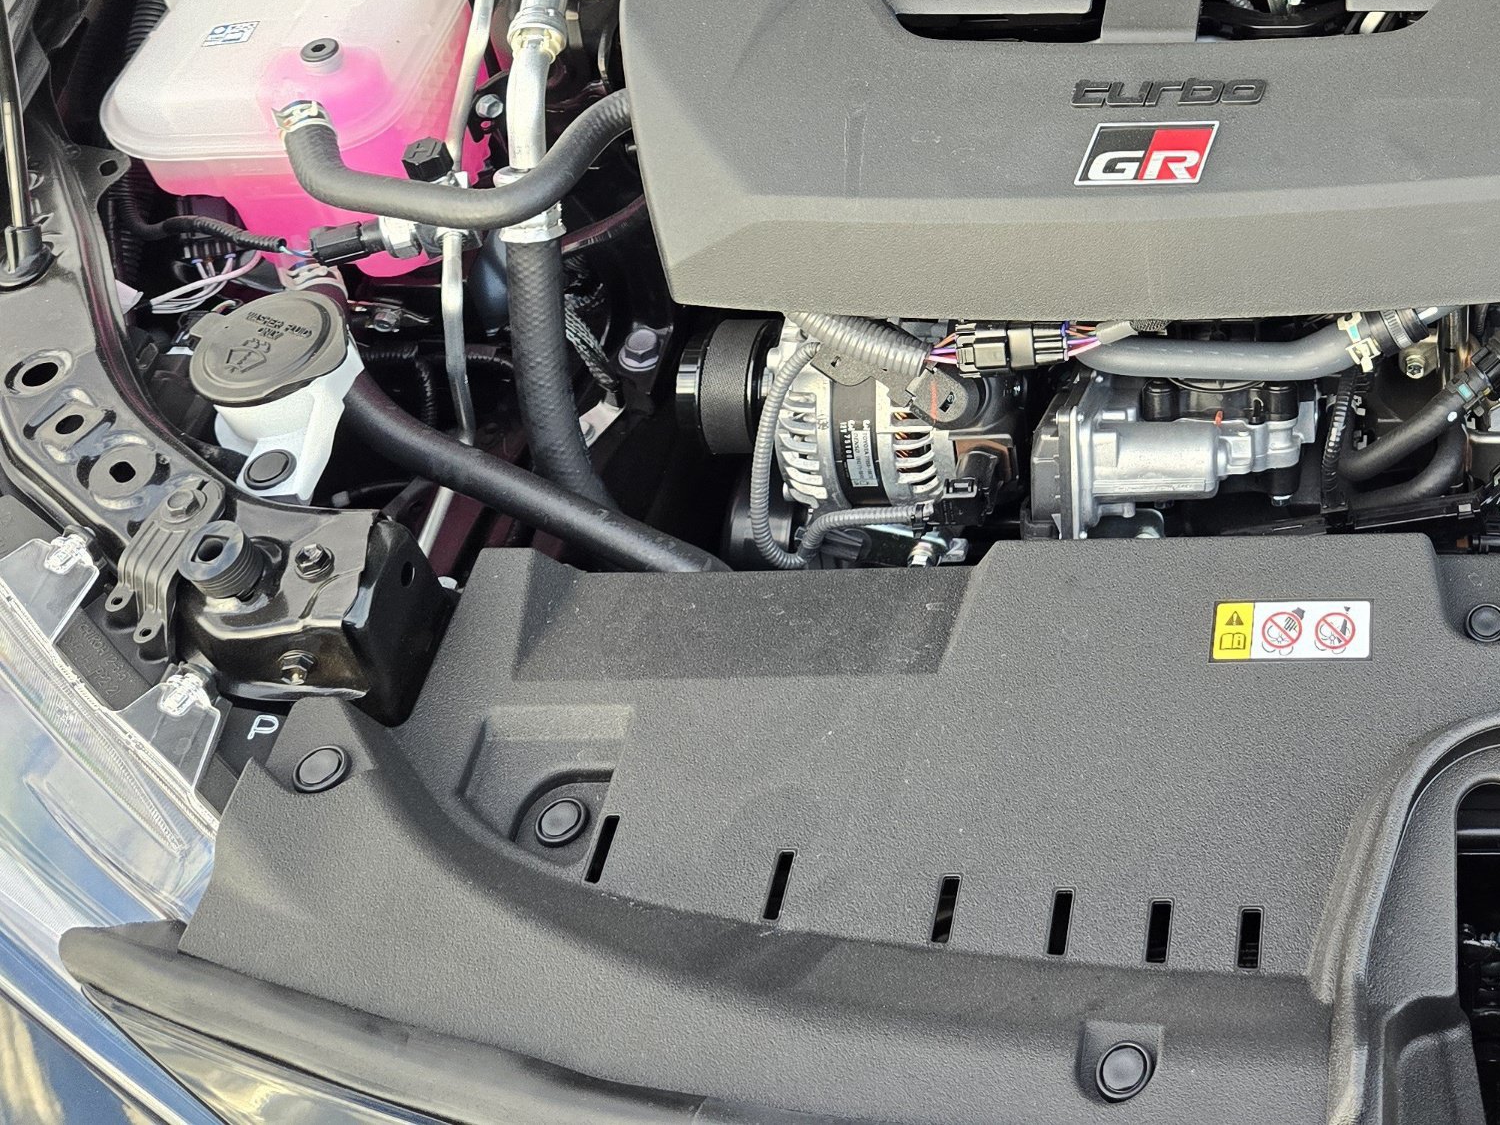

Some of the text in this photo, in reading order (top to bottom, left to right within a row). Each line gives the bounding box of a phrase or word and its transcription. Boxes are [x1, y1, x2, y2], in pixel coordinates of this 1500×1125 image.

[1070, 78, 1268, 108] turbo
[1087, 150, 1202, 180] GR
[246, 714, 280, 740] P
